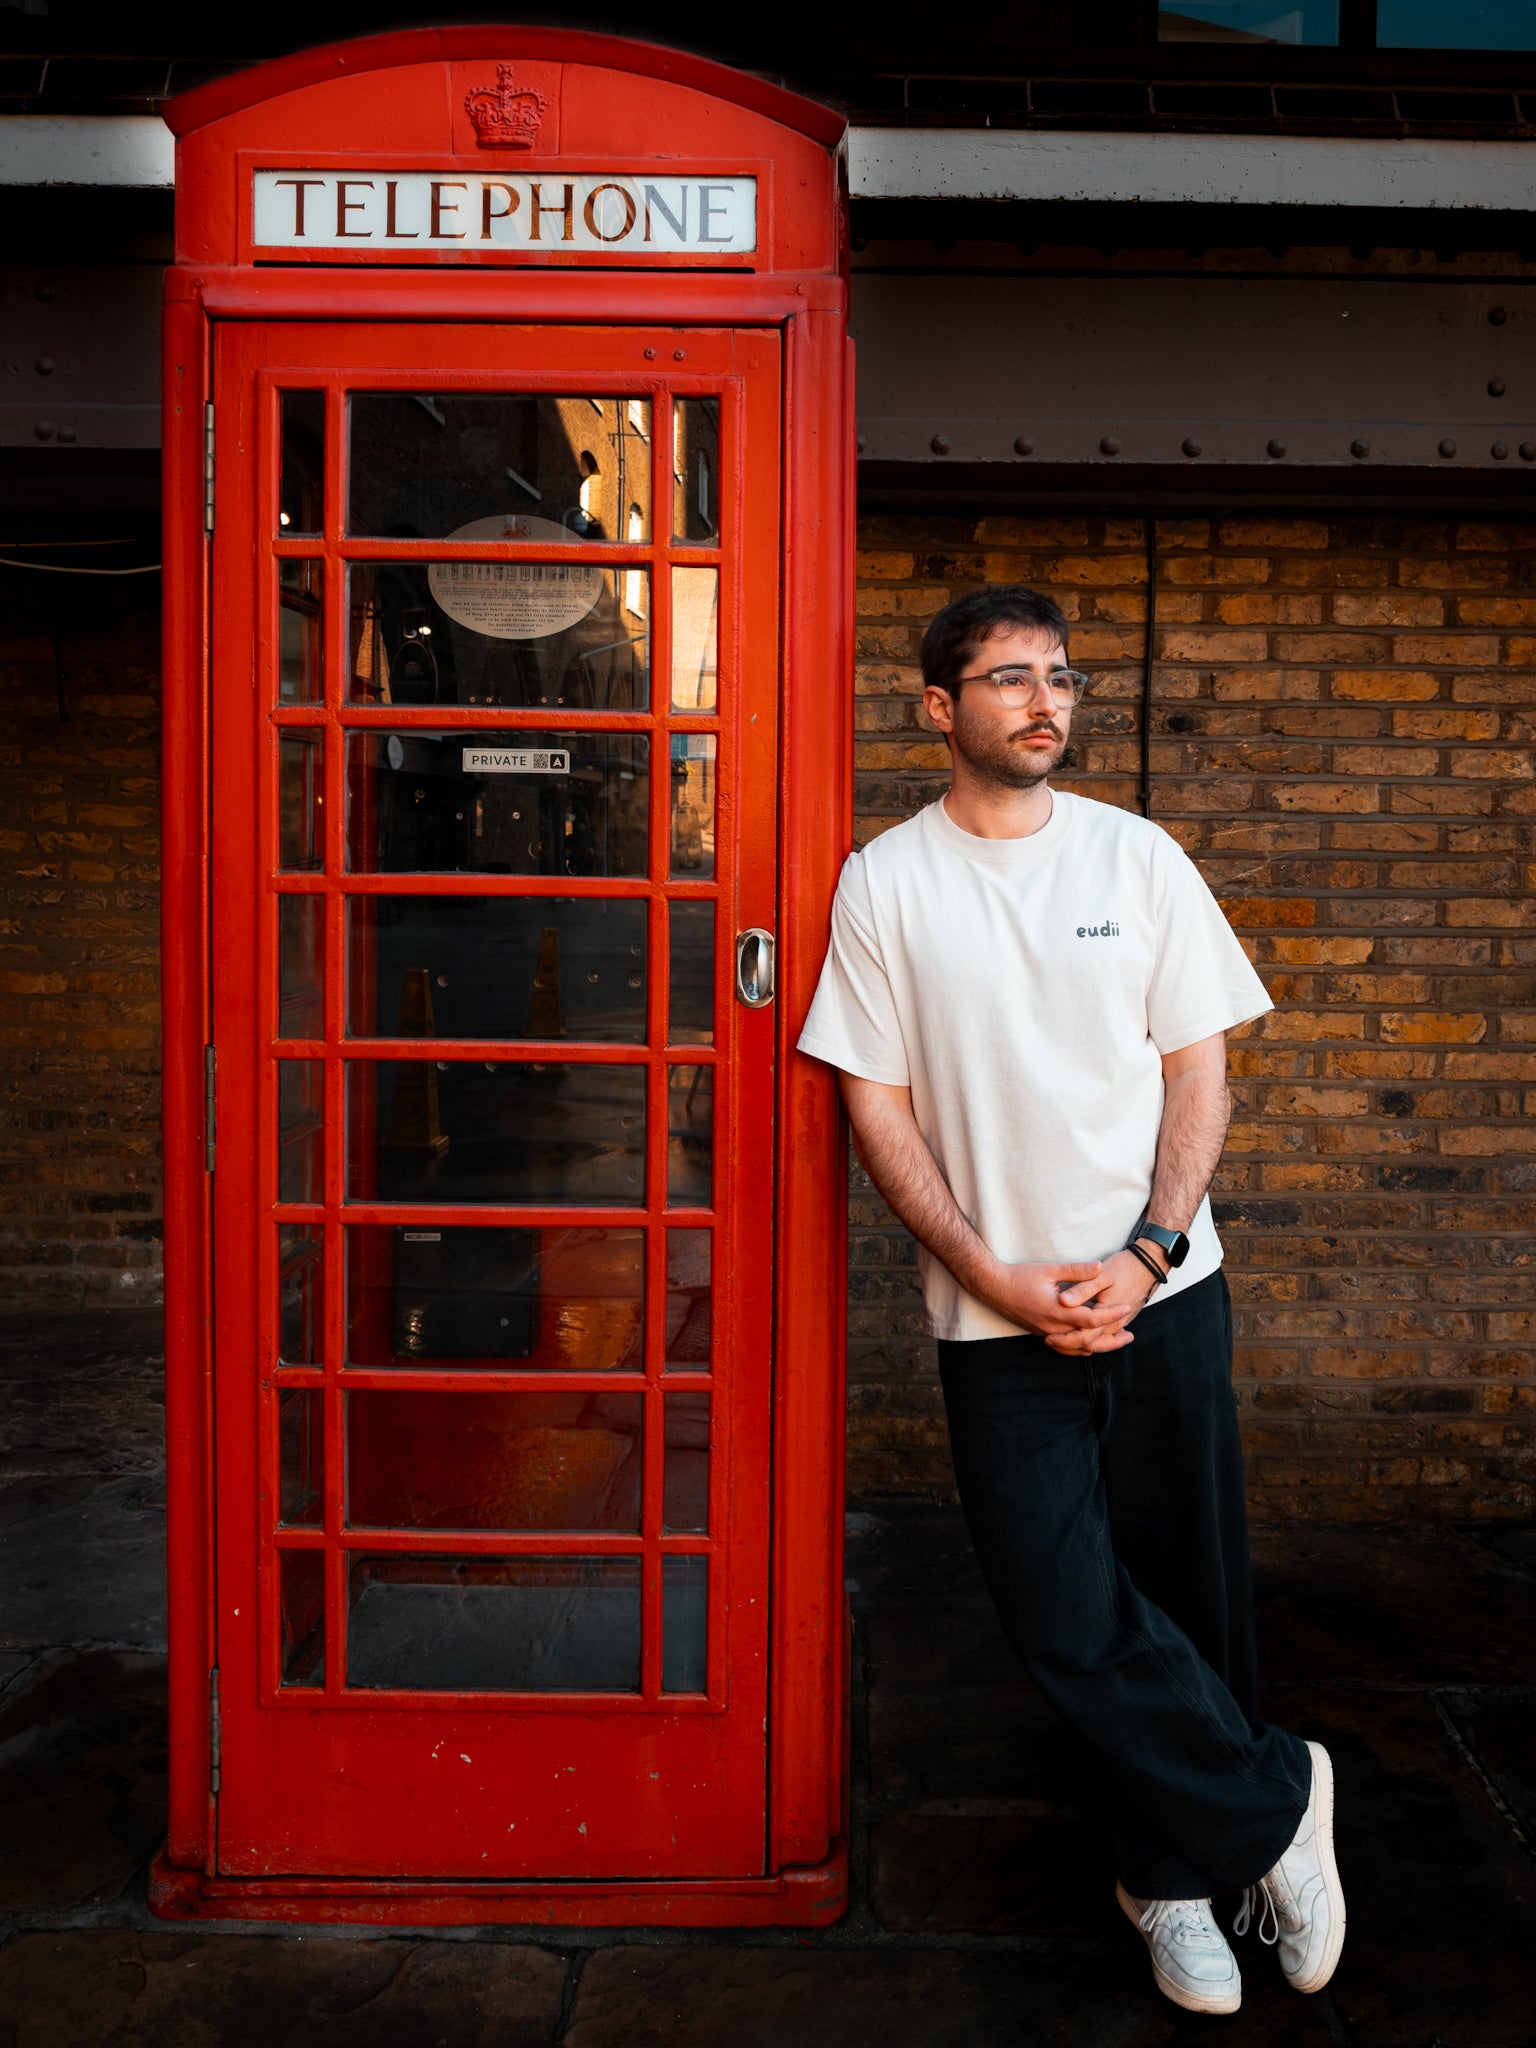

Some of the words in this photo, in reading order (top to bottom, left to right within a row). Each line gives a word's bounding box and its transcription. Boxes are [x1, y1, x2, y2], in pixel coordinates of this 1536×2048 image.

[274, 178, 735, 243] TELEPHONE
[472, 755, 527, 766] PRIVATE
[1076, 920, 1120, 938] eudii
